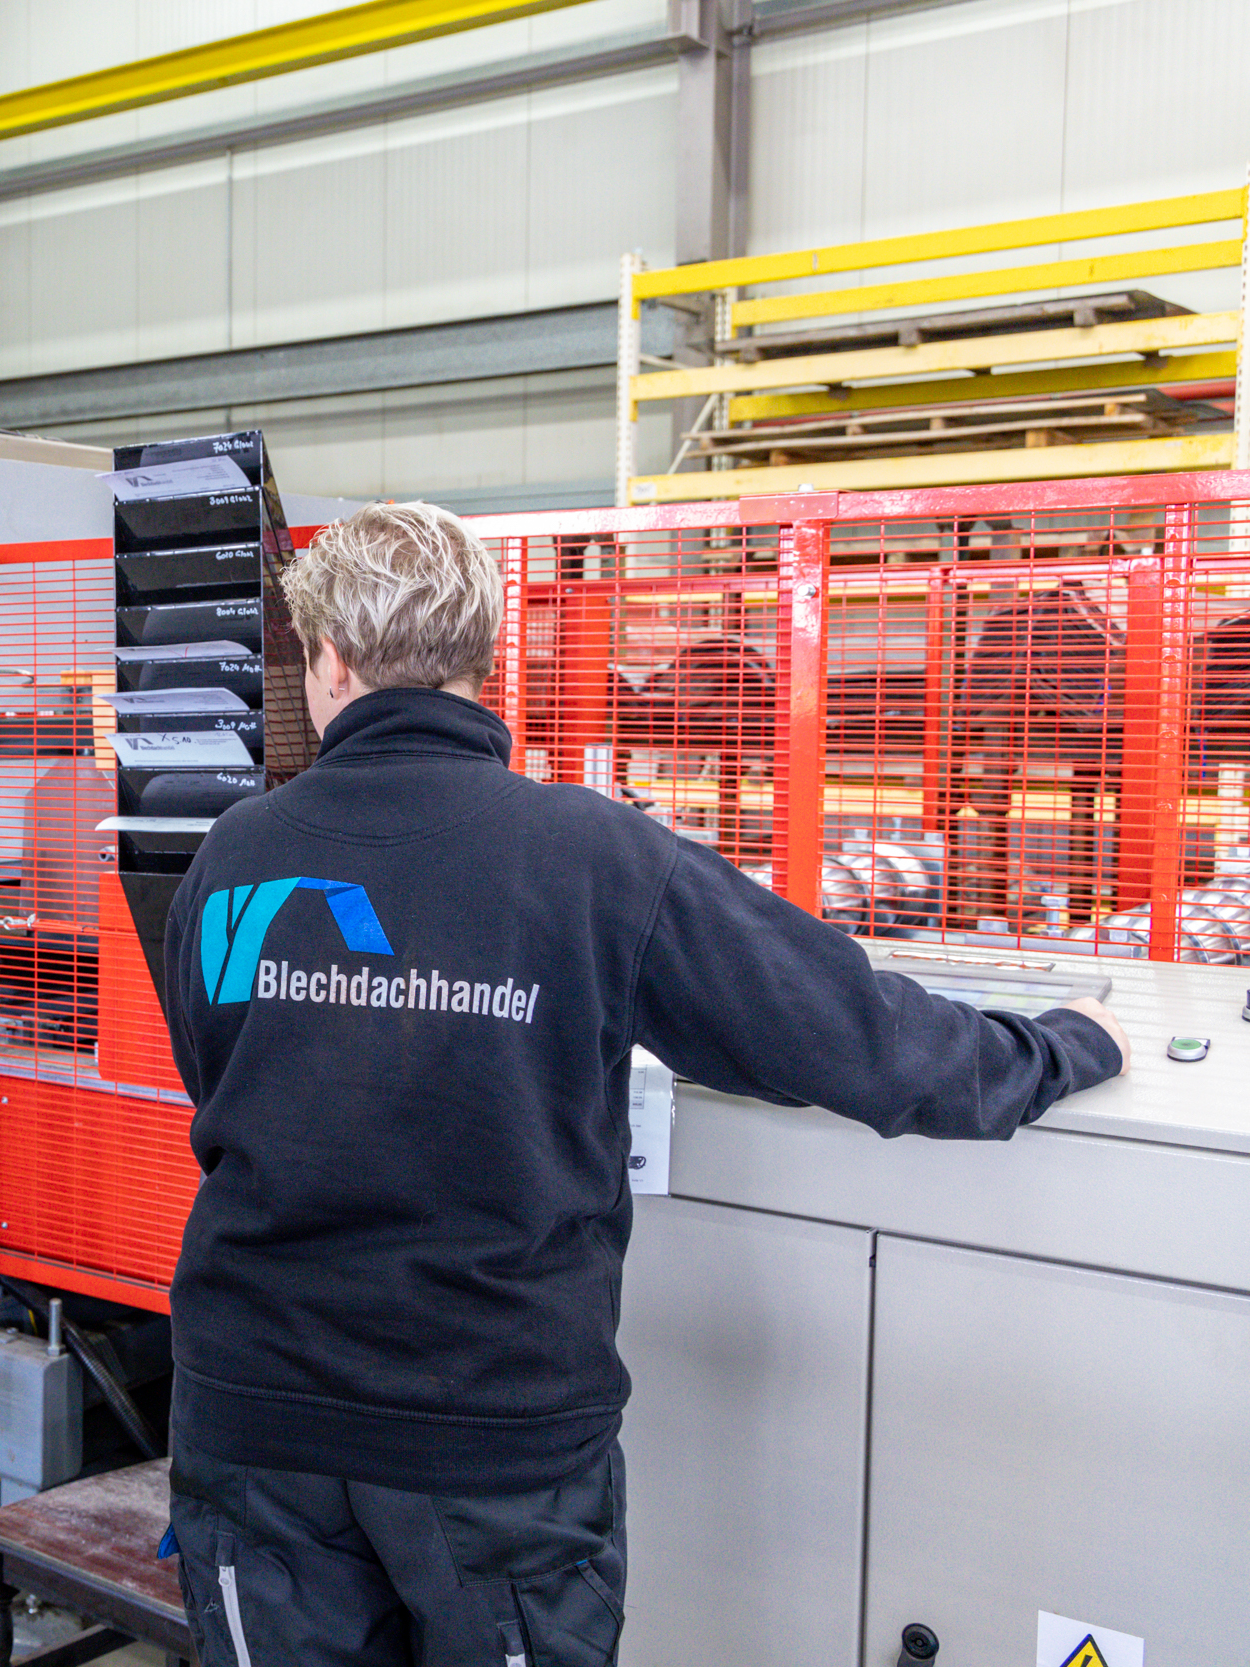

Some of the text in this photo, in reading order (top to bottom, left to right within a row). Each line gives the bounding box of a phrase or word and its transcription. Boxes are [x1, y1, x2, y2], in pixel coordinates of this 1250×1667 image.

[212, 441, 232, 454] 7024
[215, 551, 234, 561] 6020
[216, 606, 236, 617] 8004
[219, 661, 240, 672] 7024
[215, 719, 236, 730] 3009
[216, 772, 238, 784] 6020
[257, 959, 540, 1024] Blechdachhandel
